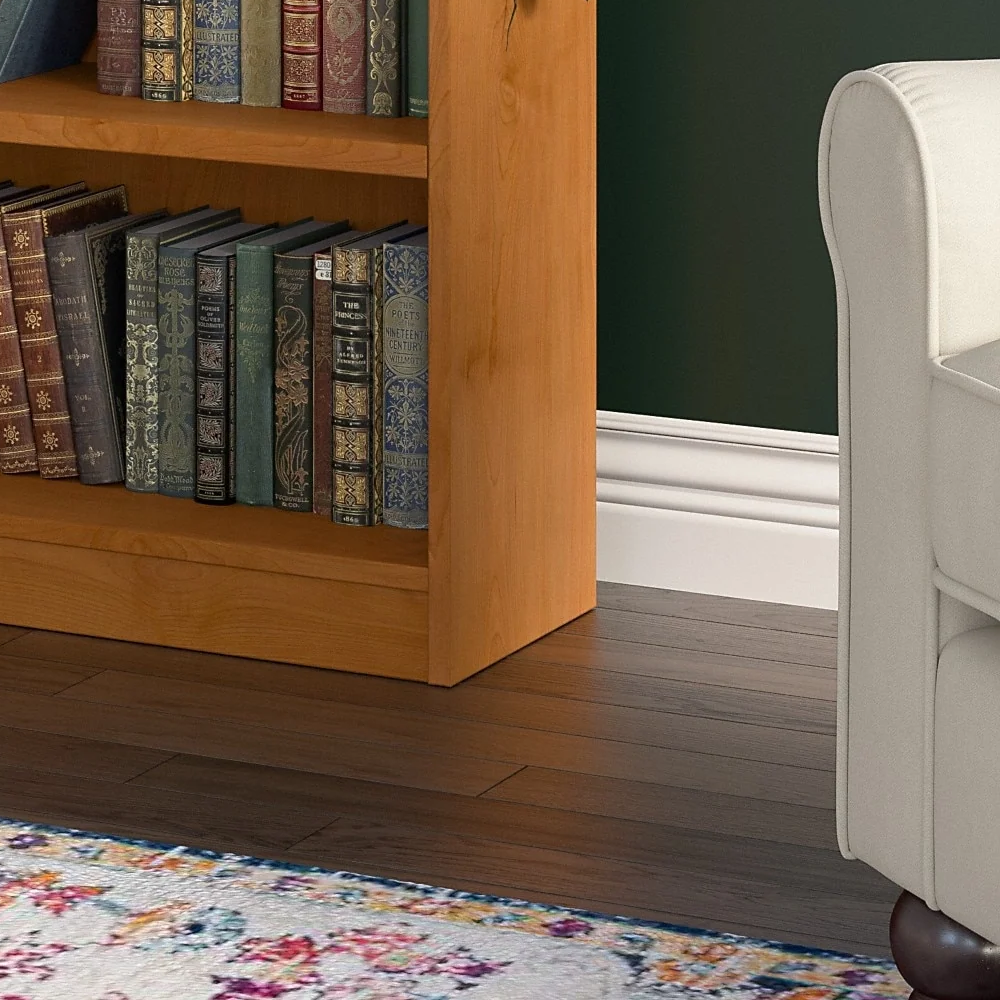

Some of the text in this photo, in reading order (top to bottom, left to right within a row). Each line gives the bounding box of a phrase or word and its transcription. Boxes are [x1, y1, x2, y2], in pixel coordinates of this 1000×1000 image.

[164, 267, 186, 277] ROSE
[391, 310, 421, 320] POETS
[389, 340, 425, 351] CENTURY
